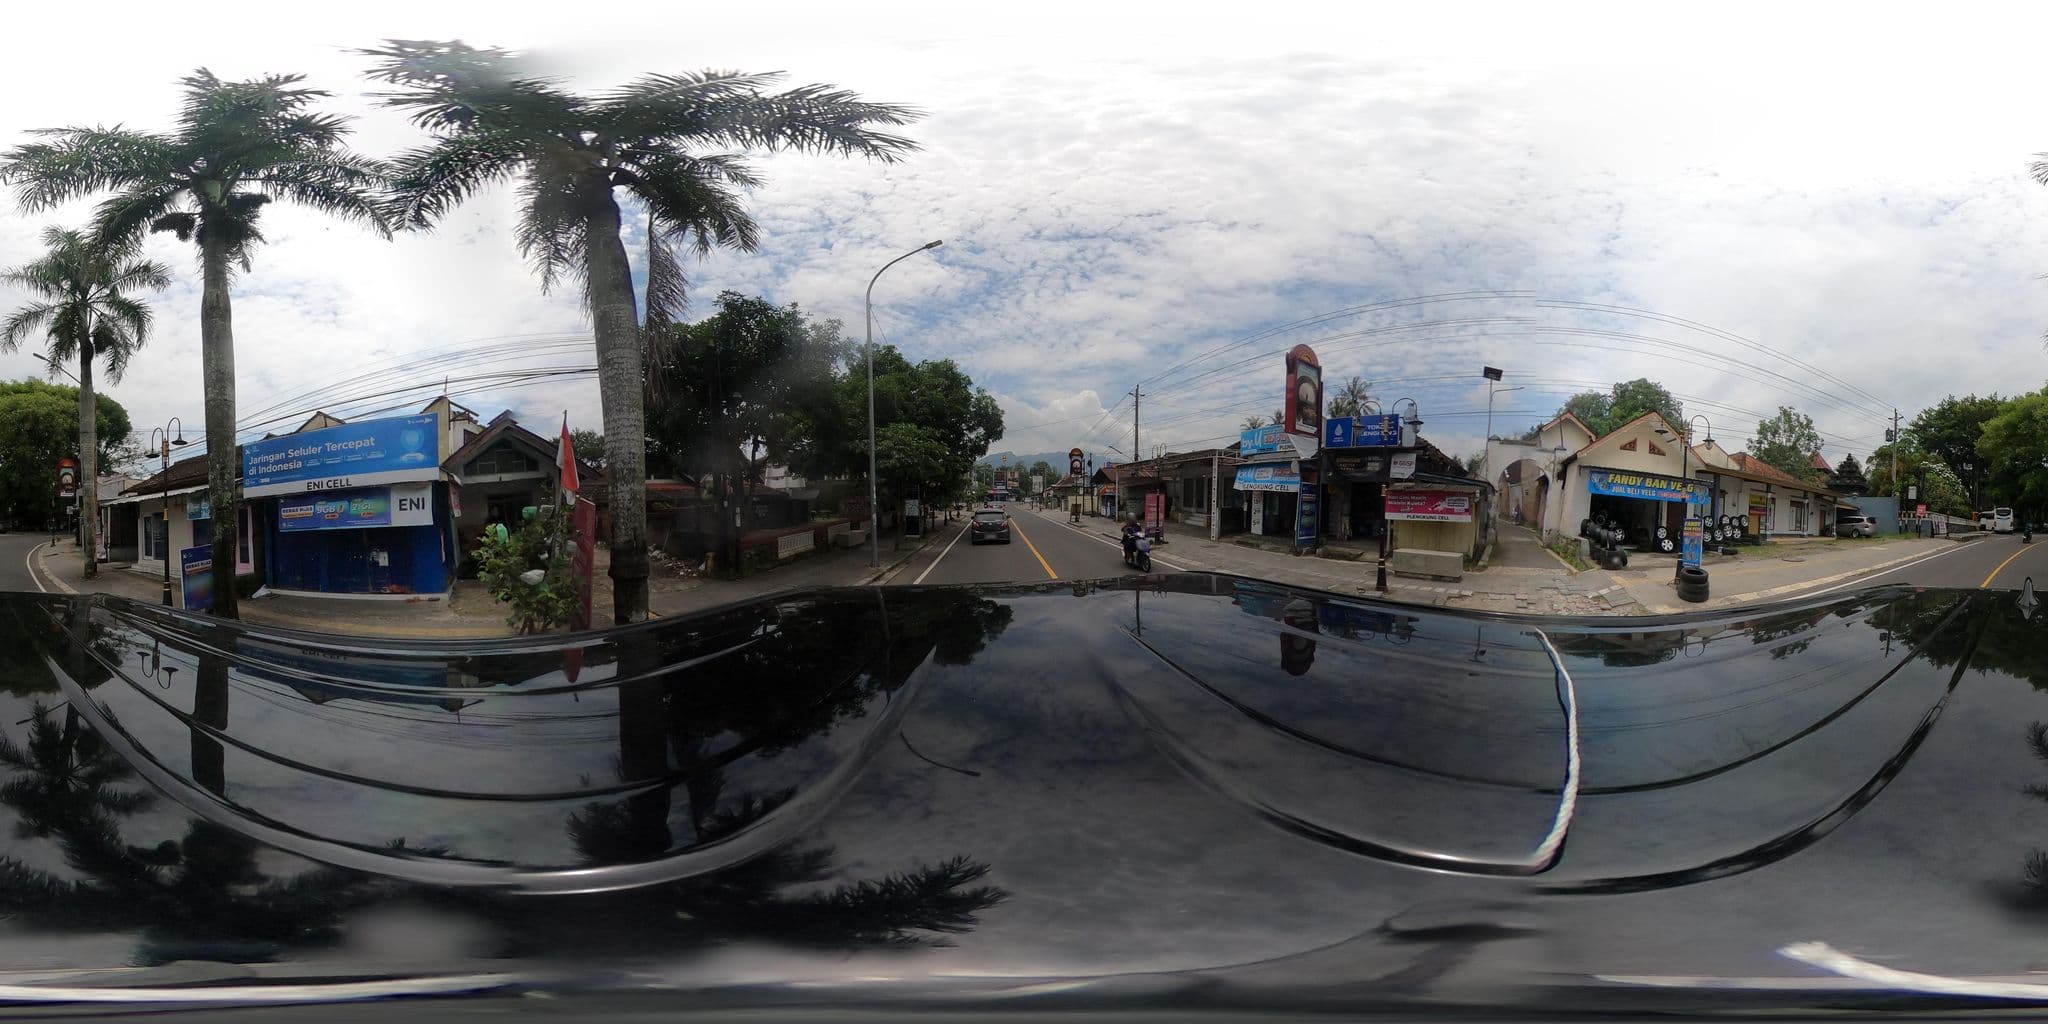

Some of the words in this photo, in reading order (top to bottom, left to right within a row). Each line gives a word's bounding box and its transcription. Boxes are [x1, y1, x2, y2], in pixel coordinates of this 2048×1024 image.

[249, 452, 286, 465] Jaringan
[288, 446, 322, 458] Seluler
[325, 436, 376, 452] Tercepat
[259, 461, 302, 474] Indonesia
[307, 480, 324, 491] ENI
[326, 478, 352, 488] CELL
[1608, 474, 1644, 486] FANDY
[1645, 479, 1667, 490] BAN
[1671, 482, 1694, 492] VEG
[1611, 486, 1625, 494] JUAL
[1641, 489, 1656, 497] VELG
[398, 497, 425, 511] ENI
